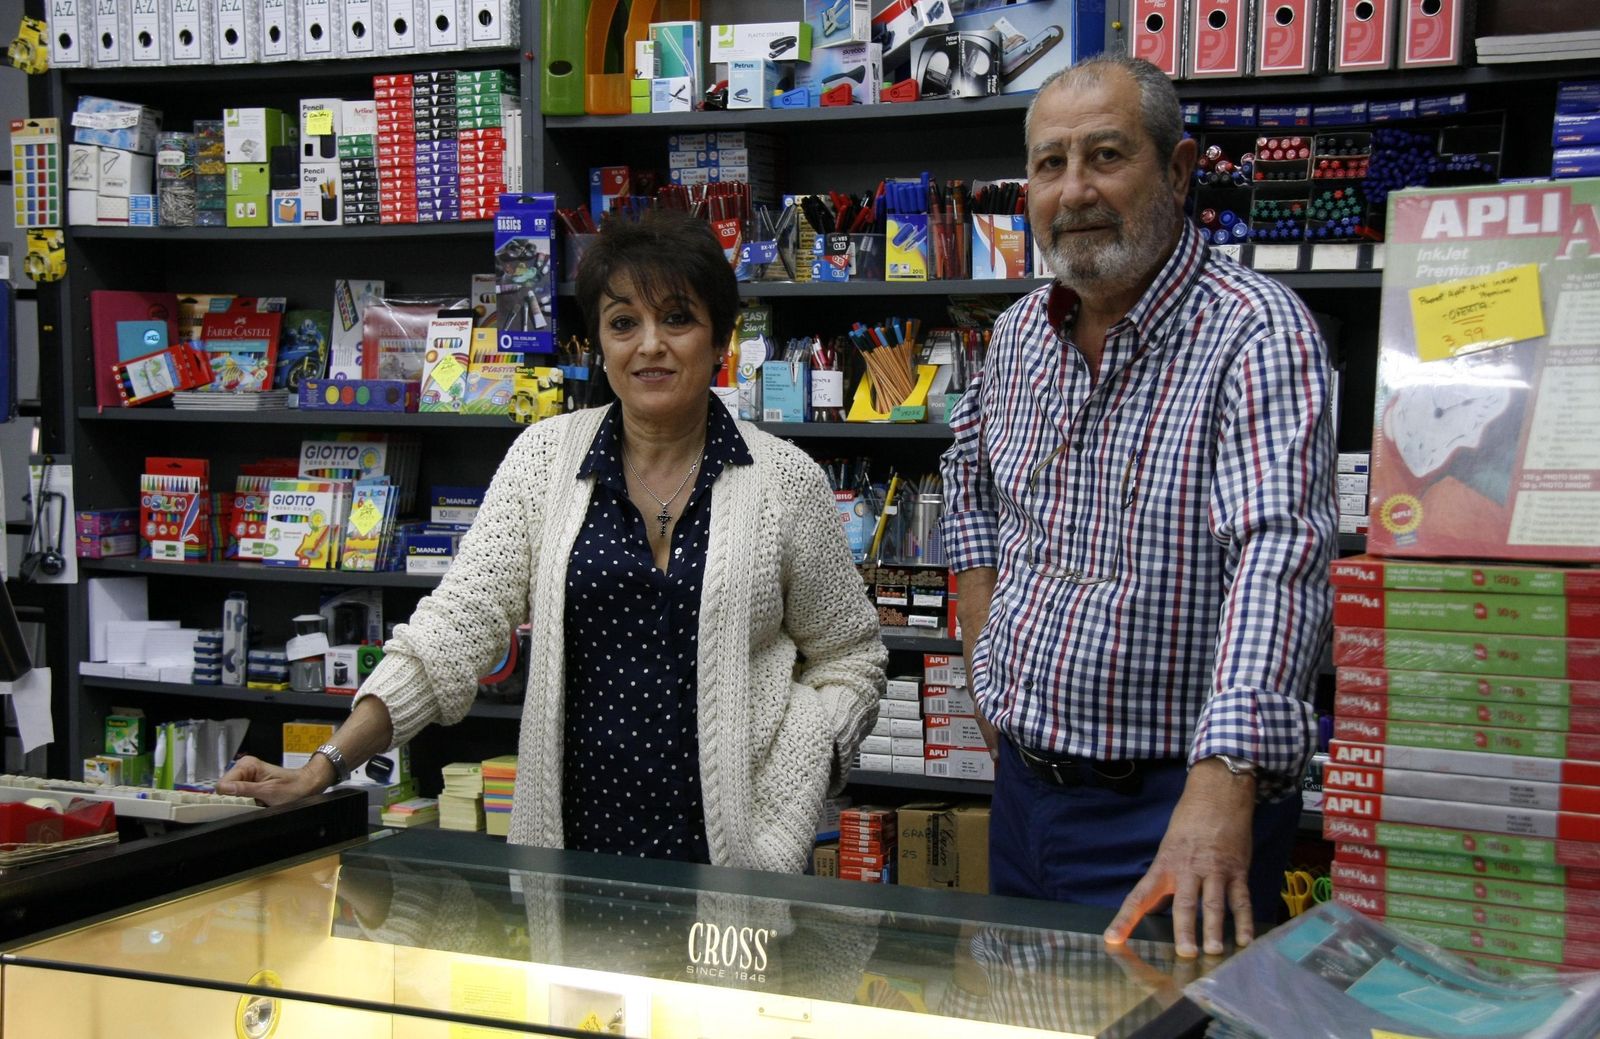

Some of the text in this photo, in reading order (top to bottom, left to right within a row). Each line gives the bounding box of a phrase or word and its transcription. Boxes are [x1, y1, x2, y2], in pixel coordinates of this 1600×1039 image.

[1421, 192, 1561, 239] APLI
[497, 219, 521, 230] BASICS
[1417, 247, 1469, 262] InkJet
[1416, 264, 1491, 278] Premium
[742, 312, 769, 321] EASY
[207, 326, 271, 337] FABER-CASTELL
[742, 323, 766, 332] Start
[305, 445, 359, 460] GIOTTO
[272, 494, 315, 506] GIOTTO
[1358, 571, 1376, 580] A4
[1362, 598, 1380, 608] A4
[1336, 747, 1381, 764] APLI
[1328, 770, 1373, 787] APLI
[1326, 797, 1372, 814] APLI
[1360, 874, 1376, 884] A4
[688, 922, 769, 971] CROSS
[686, 966, 766, 983] SINCE 1846
